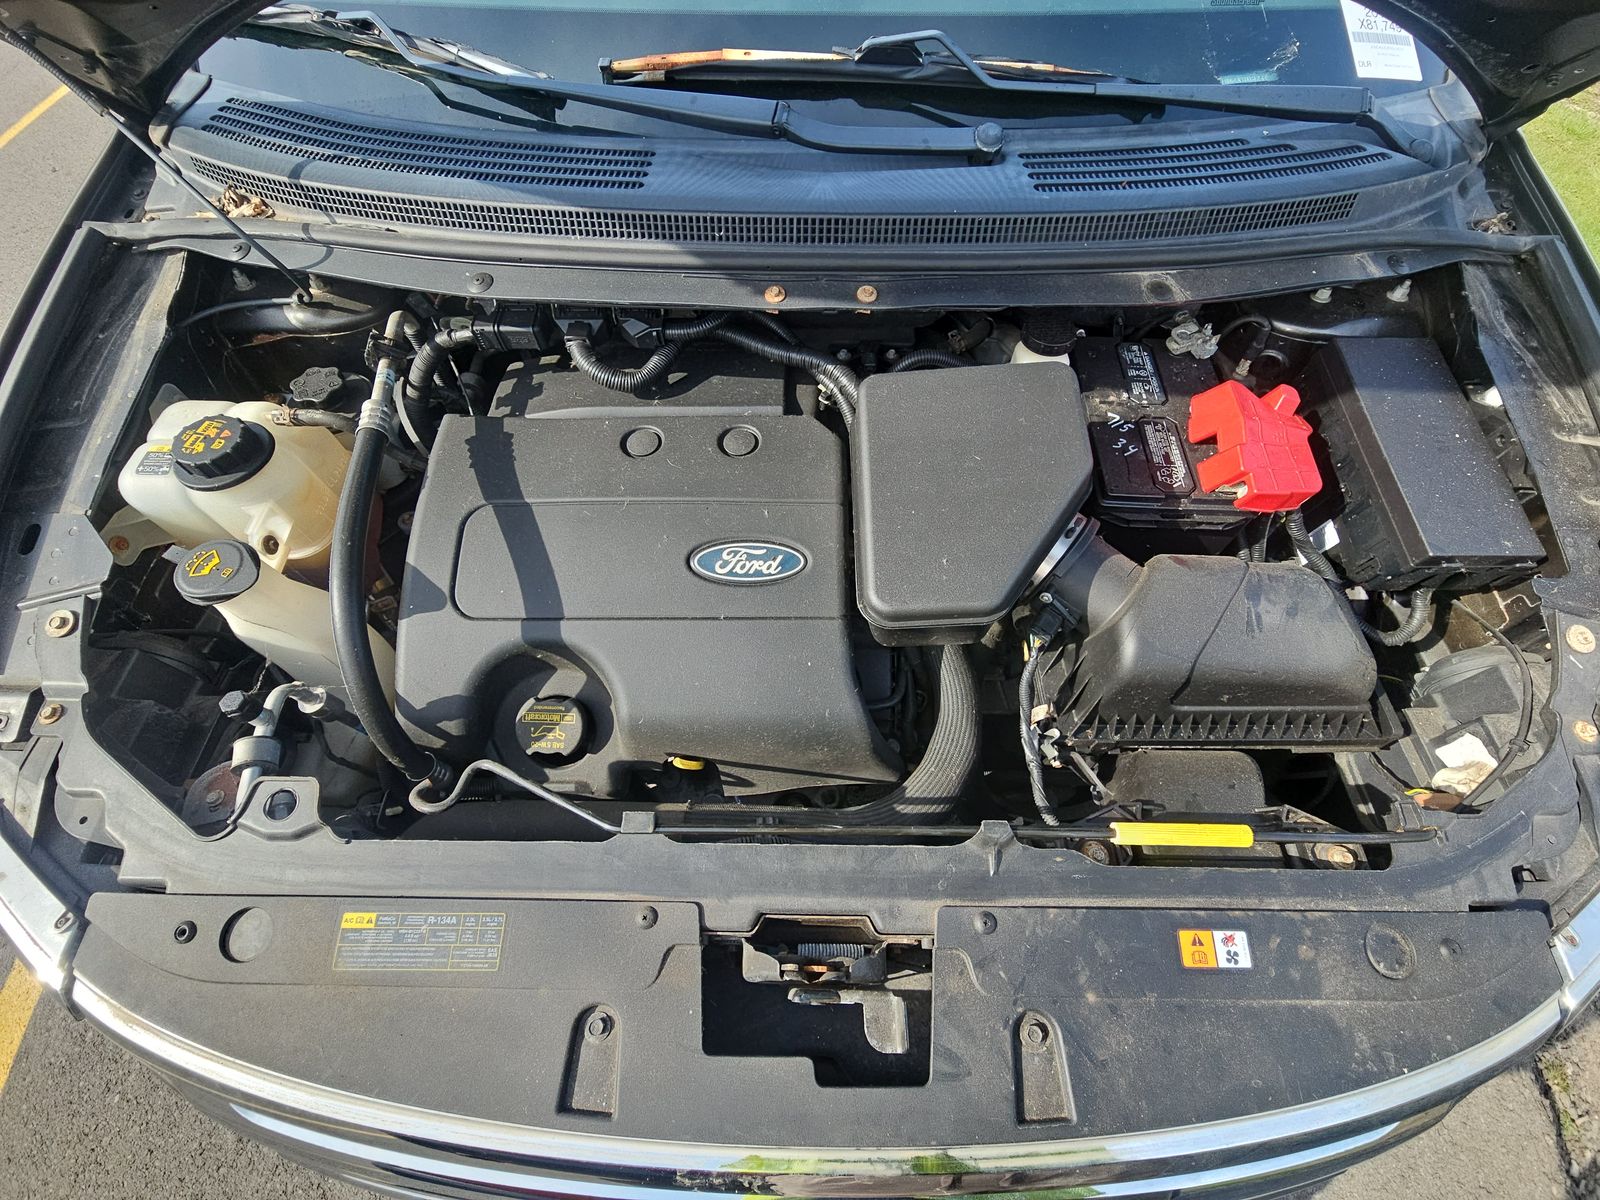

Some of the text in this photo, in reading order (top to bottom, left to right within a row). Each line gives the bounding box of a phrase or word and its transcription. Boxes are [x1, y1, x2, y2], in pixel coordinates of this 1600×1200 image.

[1358, 60, 1372, 68] DLR
[715, 547, 782, 574] Ford
[525, 713, 560, 722] Motorcraft
[427, 916, 457, 925] R-134A
